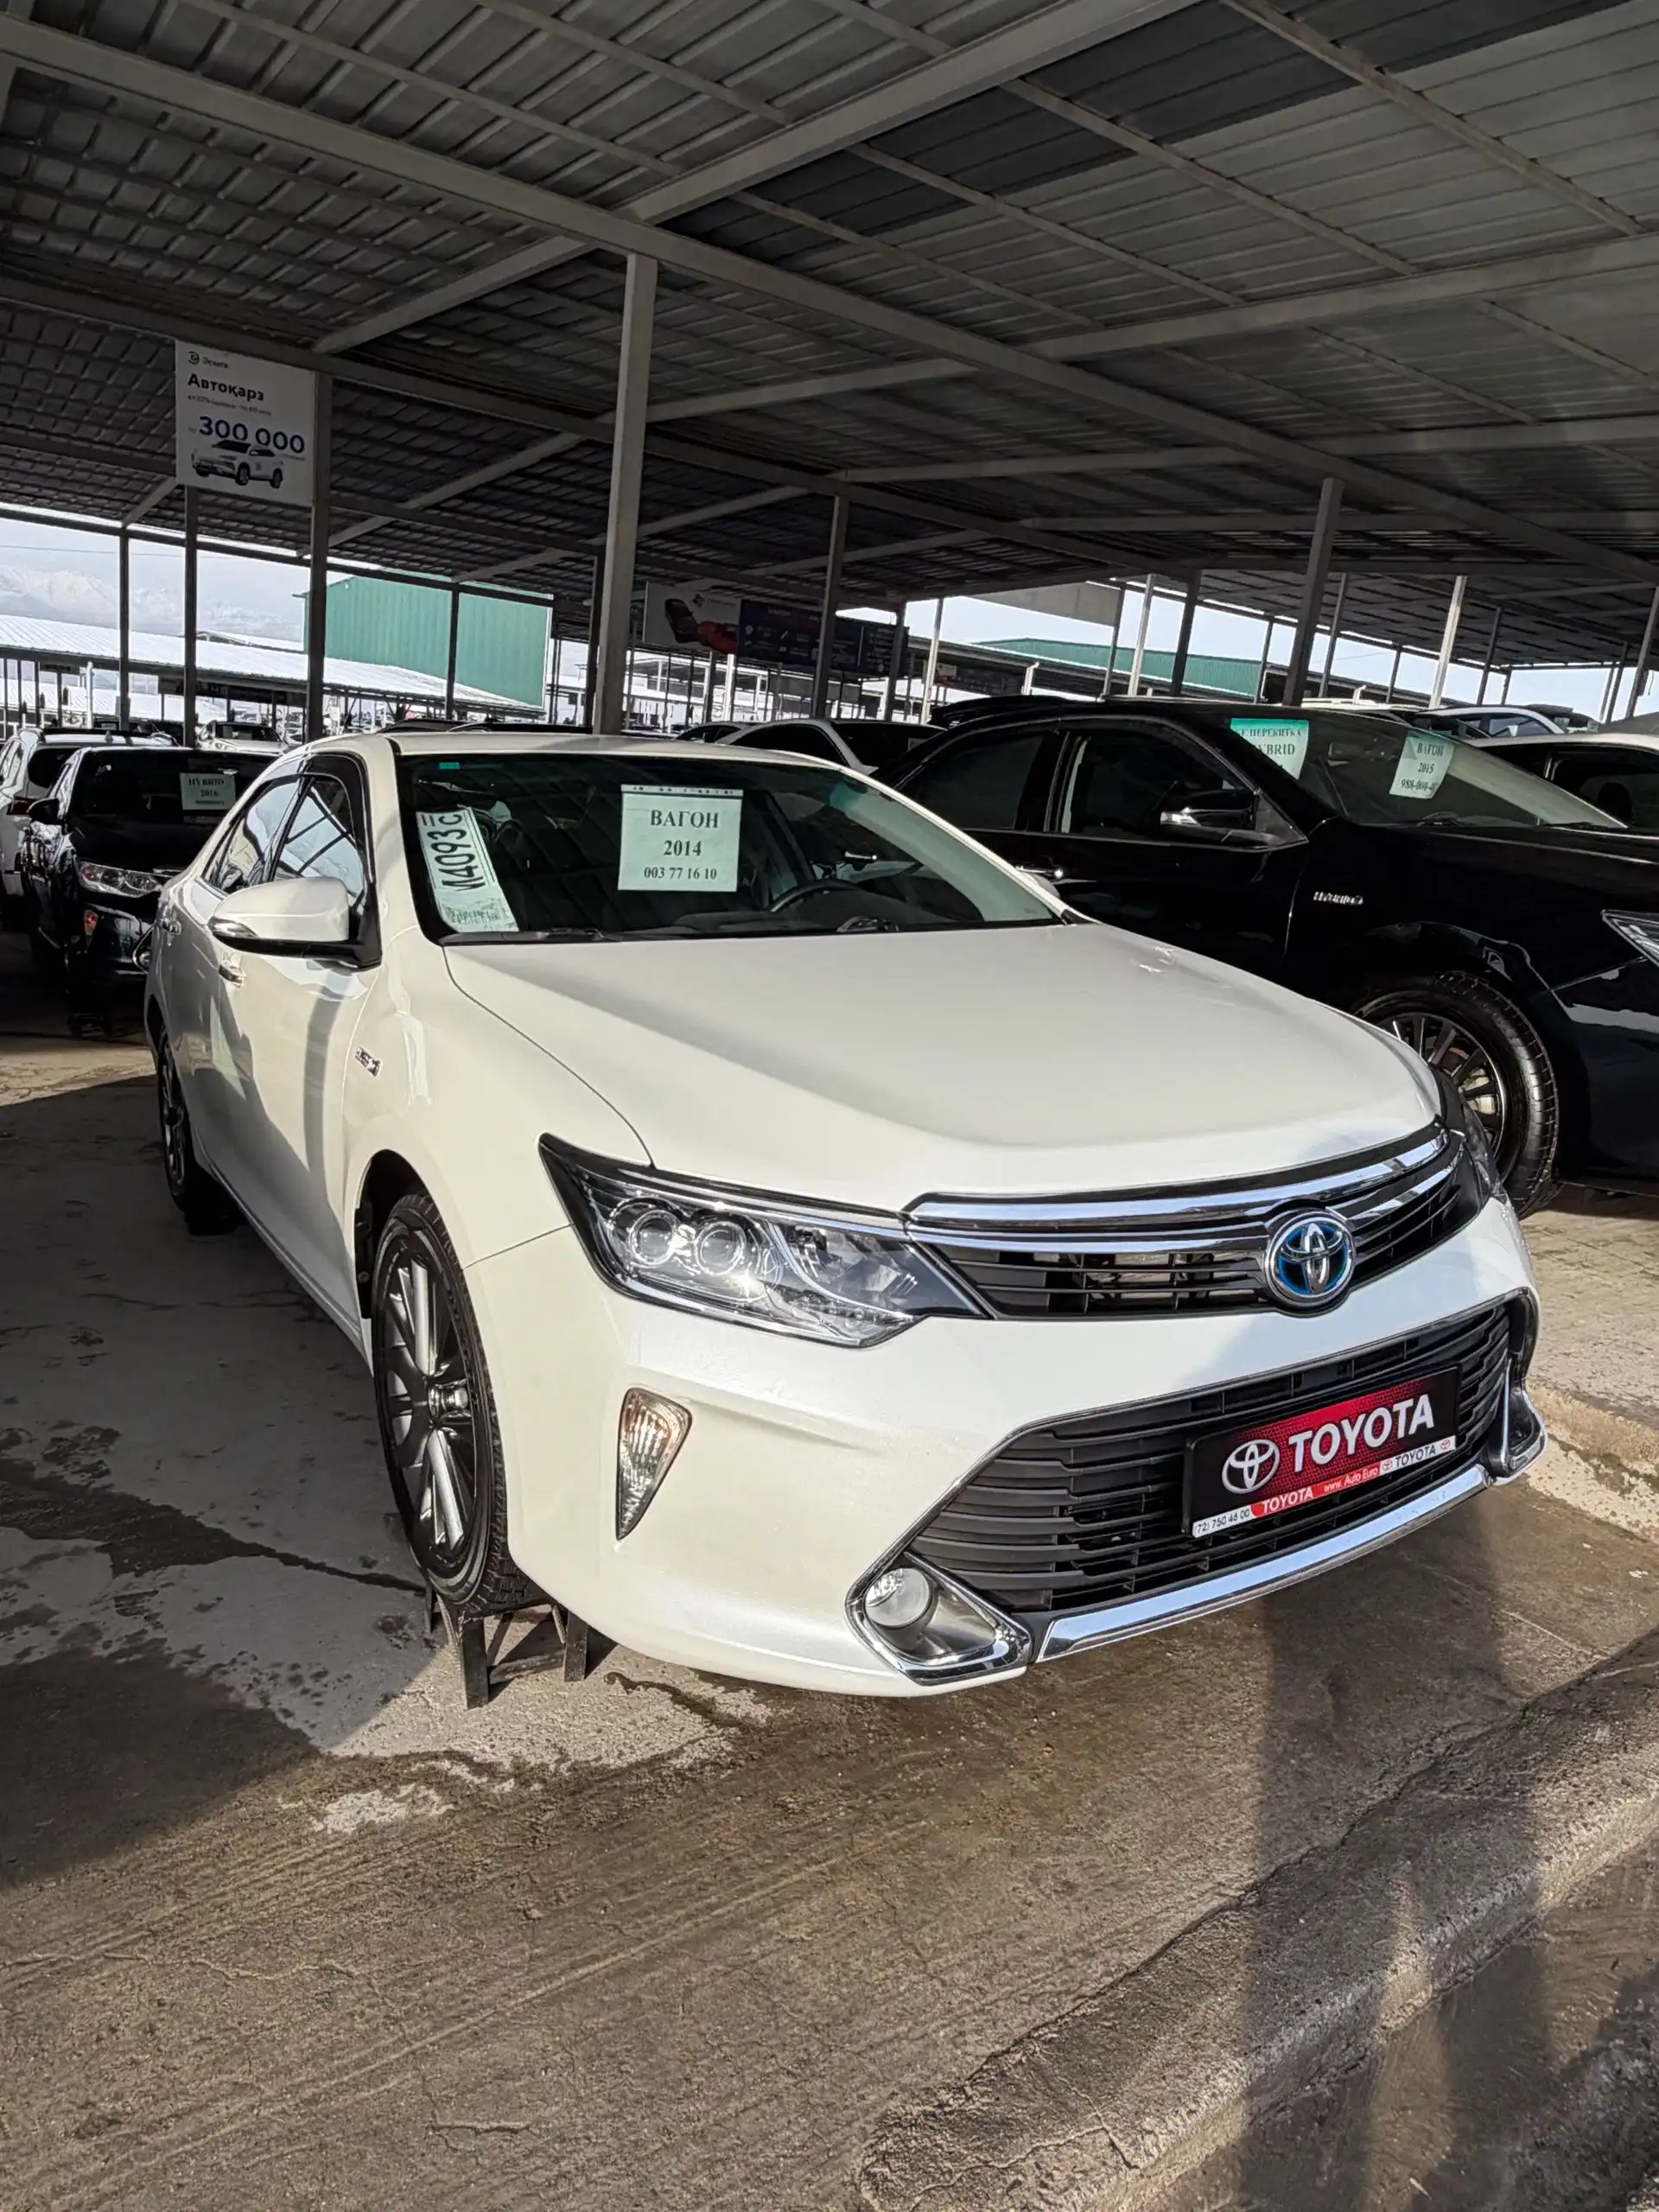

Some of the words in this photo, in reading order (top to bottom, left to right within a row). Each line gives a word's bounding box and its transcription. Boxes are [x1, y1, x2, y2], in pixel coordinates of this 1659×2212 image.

[188, 373, 264, 402] Автоқарз
[199, 416, 248, 442] 300
[255, 428, 305, 454] 000
[1417, 761, 1435, 775] 2015
[650, 809, 719, 829] ВАГОН
[663, 839, 702, 856] 2014
[644, 867, 665, 879] 003
[669, 867, 683, 880] 77
[687, 868, 701, 880] 16
[704, 868, 717, 880] 10
[1287, 1394, 1435, 1473] TOYOTA
[1261, 1485, 1314, 1515] TOYOTA
[1344, 1471, 1362, 1488] Auto
[1362, 1466, 1379, 1482] Euro
[1395, 1444, 1436, 1470] TOYOTA
